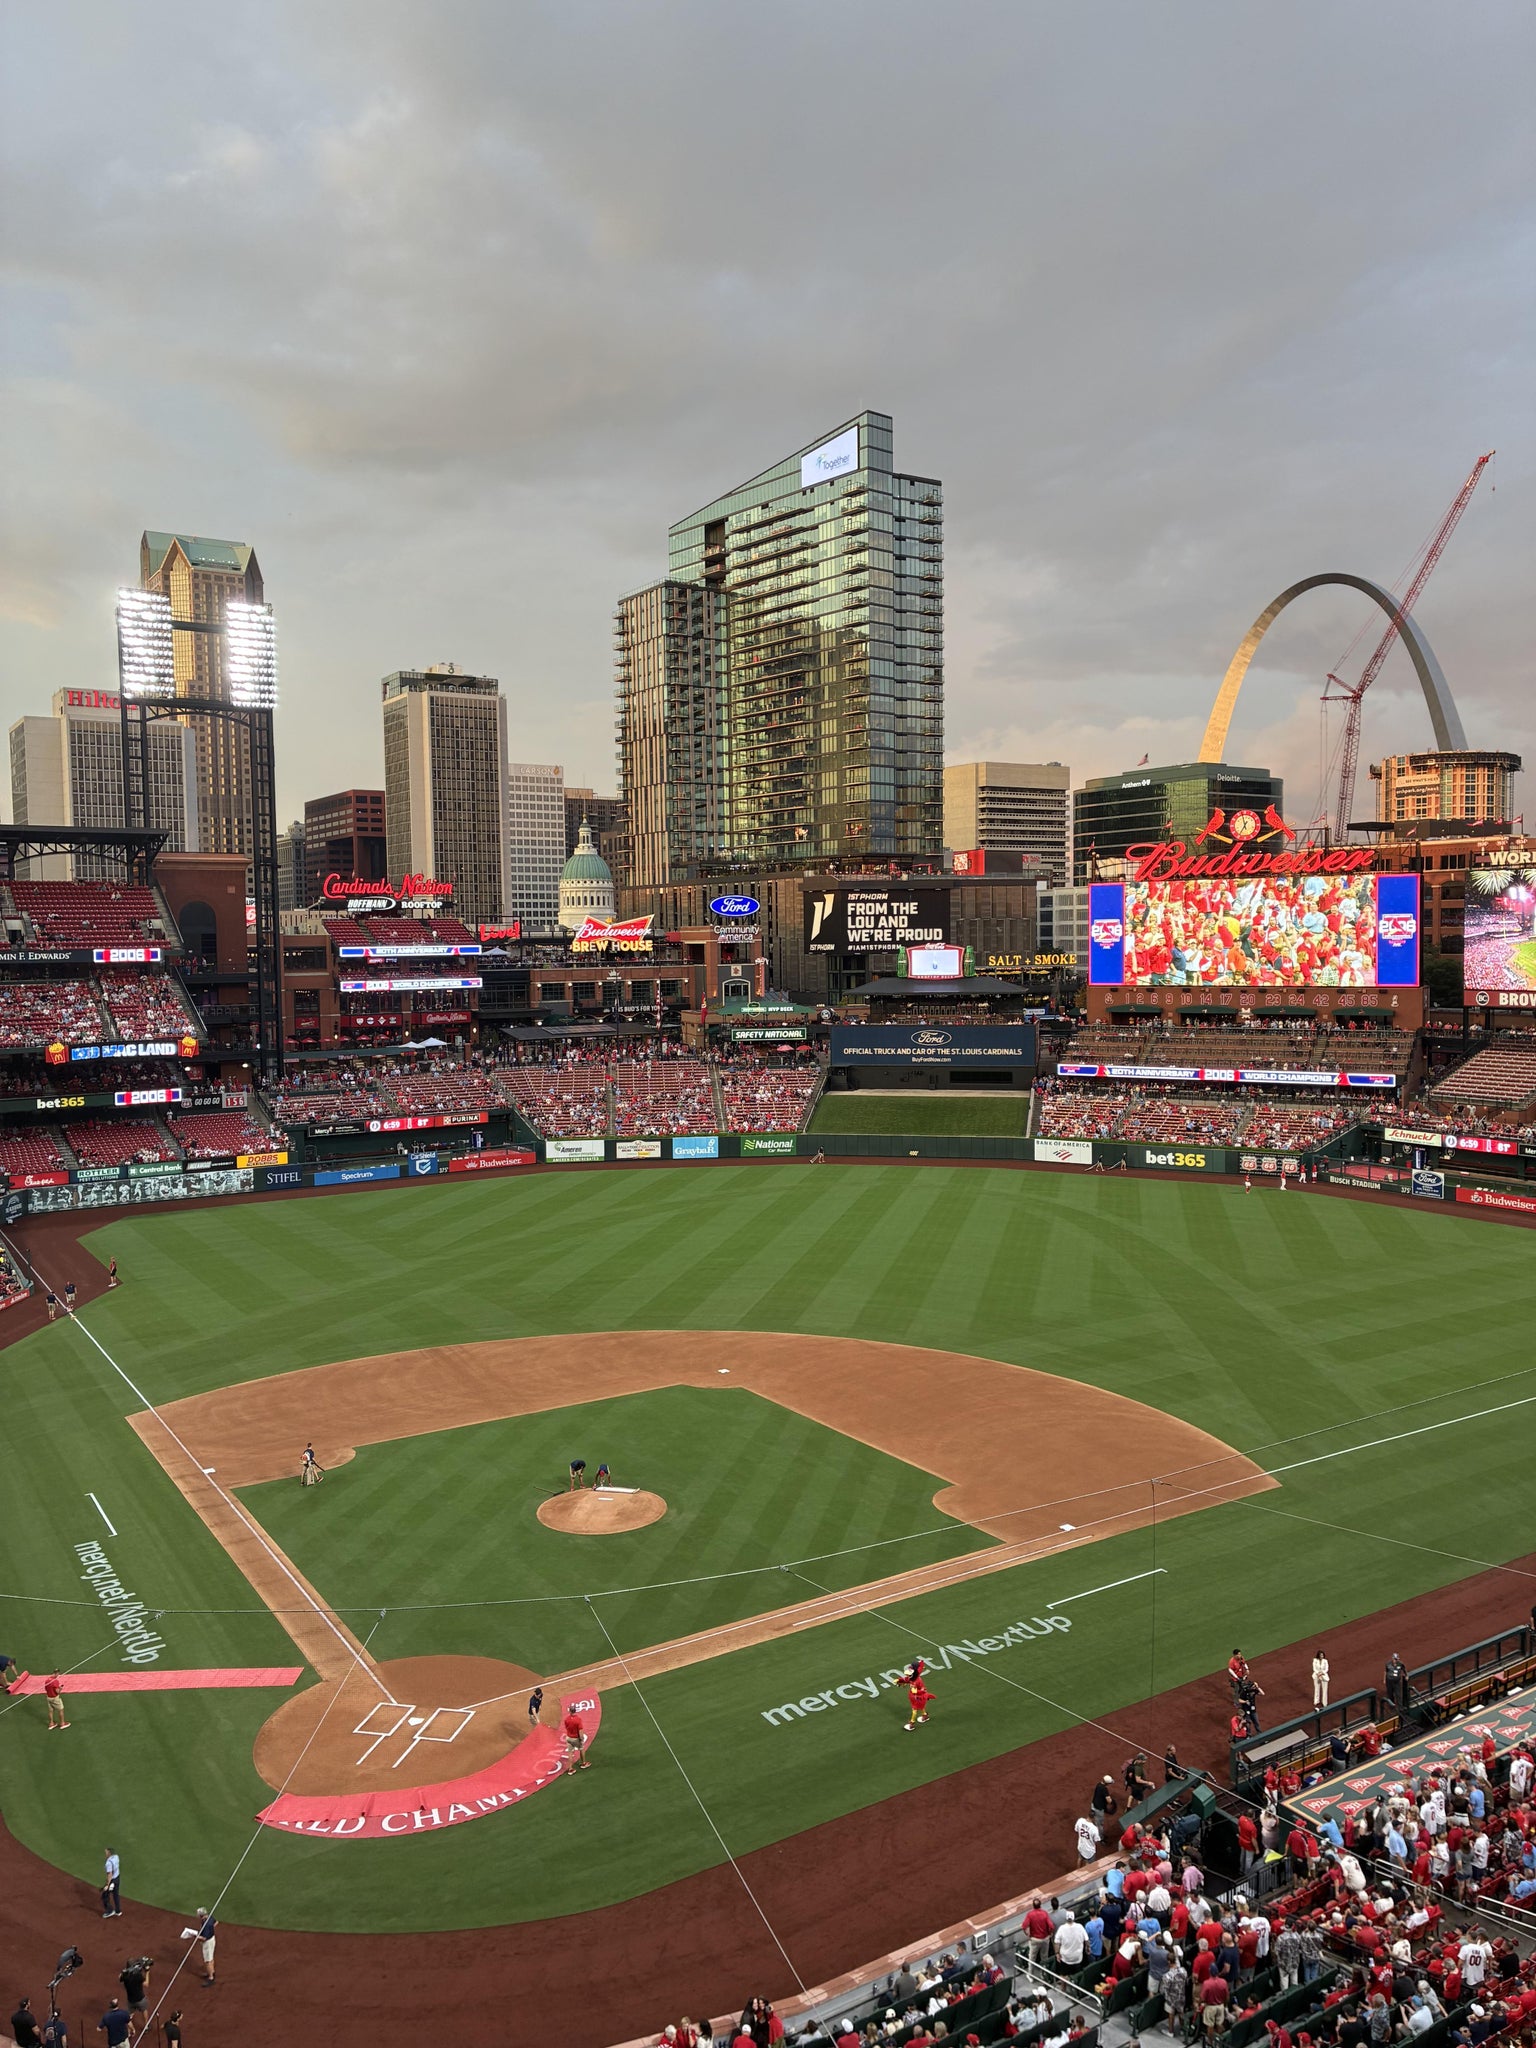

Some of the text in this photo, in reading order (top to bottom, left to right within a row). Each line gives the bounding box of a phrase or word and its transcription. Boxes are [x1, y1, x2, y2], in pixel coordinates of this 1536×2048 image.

[822, 455, 850, 470] Together
[67, 690, 138, 711] Hilto
[1122, 781, 1141, 790] Anthem
[1126, 841, 1376, 881] Budweiser
[323, 873, 453, 899] Cardinals Nation
[348, 899, 388, 908] HOFFMANN
[720, 896, 750, 912] Ford
[848, 902, 918, 915] FROM THE
[848, 916, 908, 928] LOU AND
[480, 922, 521, 942] Live!
[573, 922, 652, 938] Budweiser
[714, 926, 760, 934] Community
[848, 928, 942, 942] WE'RE PROUD
[572, 940, 652, 952] BREW HOUSE
[19, 952, 26, 960] F.
[988, 956, 1021, 966] SALT
[1034, 954, 1077, 965] SMOKE
[1125, 993, 1378, 1006] 1 2 6 9 10 14 17 20 23 24 42 45 85
[918, 1032, 944, 1043] Ford
[138, 1044, 176, 1056] LAND
[1205, 1070, 1234, 1080] 2006
[37, 1097, 84, 1109] bet365
[131, 1091, 167, 1103] 2006
[384, 1121, 400, 1129] 6:59
[1389, 1130, 1436, 1141] Schnucks
[755, 1140, 792, 1149] National
[1460, 1139, 1478, 1148] 6:59
[411, 1152, 436, 1160] CarShield
[1146, 1150, 1206, 1167] bet365
[480, 1158, 522, 1168] Budweiser
[79, 1168, 118, 1176] ROTTLER
[267, 1172, 301, 1184] STIFEL
[1419, 1172, 1437, 1184] Ford
[1330, 1176, 1380, 1190] BUSCH STADIUM
[1485, 1194, 1536, 1210] Budweiser
[74, 1540, 166, 1664] mercy.net/NextUp
[1352, 1779, 1370, 1789] 1934
[1308, 1799, 1330, 1809] 1926
[1080, 1828, 1090, 1840] 23
[1469, 1956, 1482, 1966] 00
